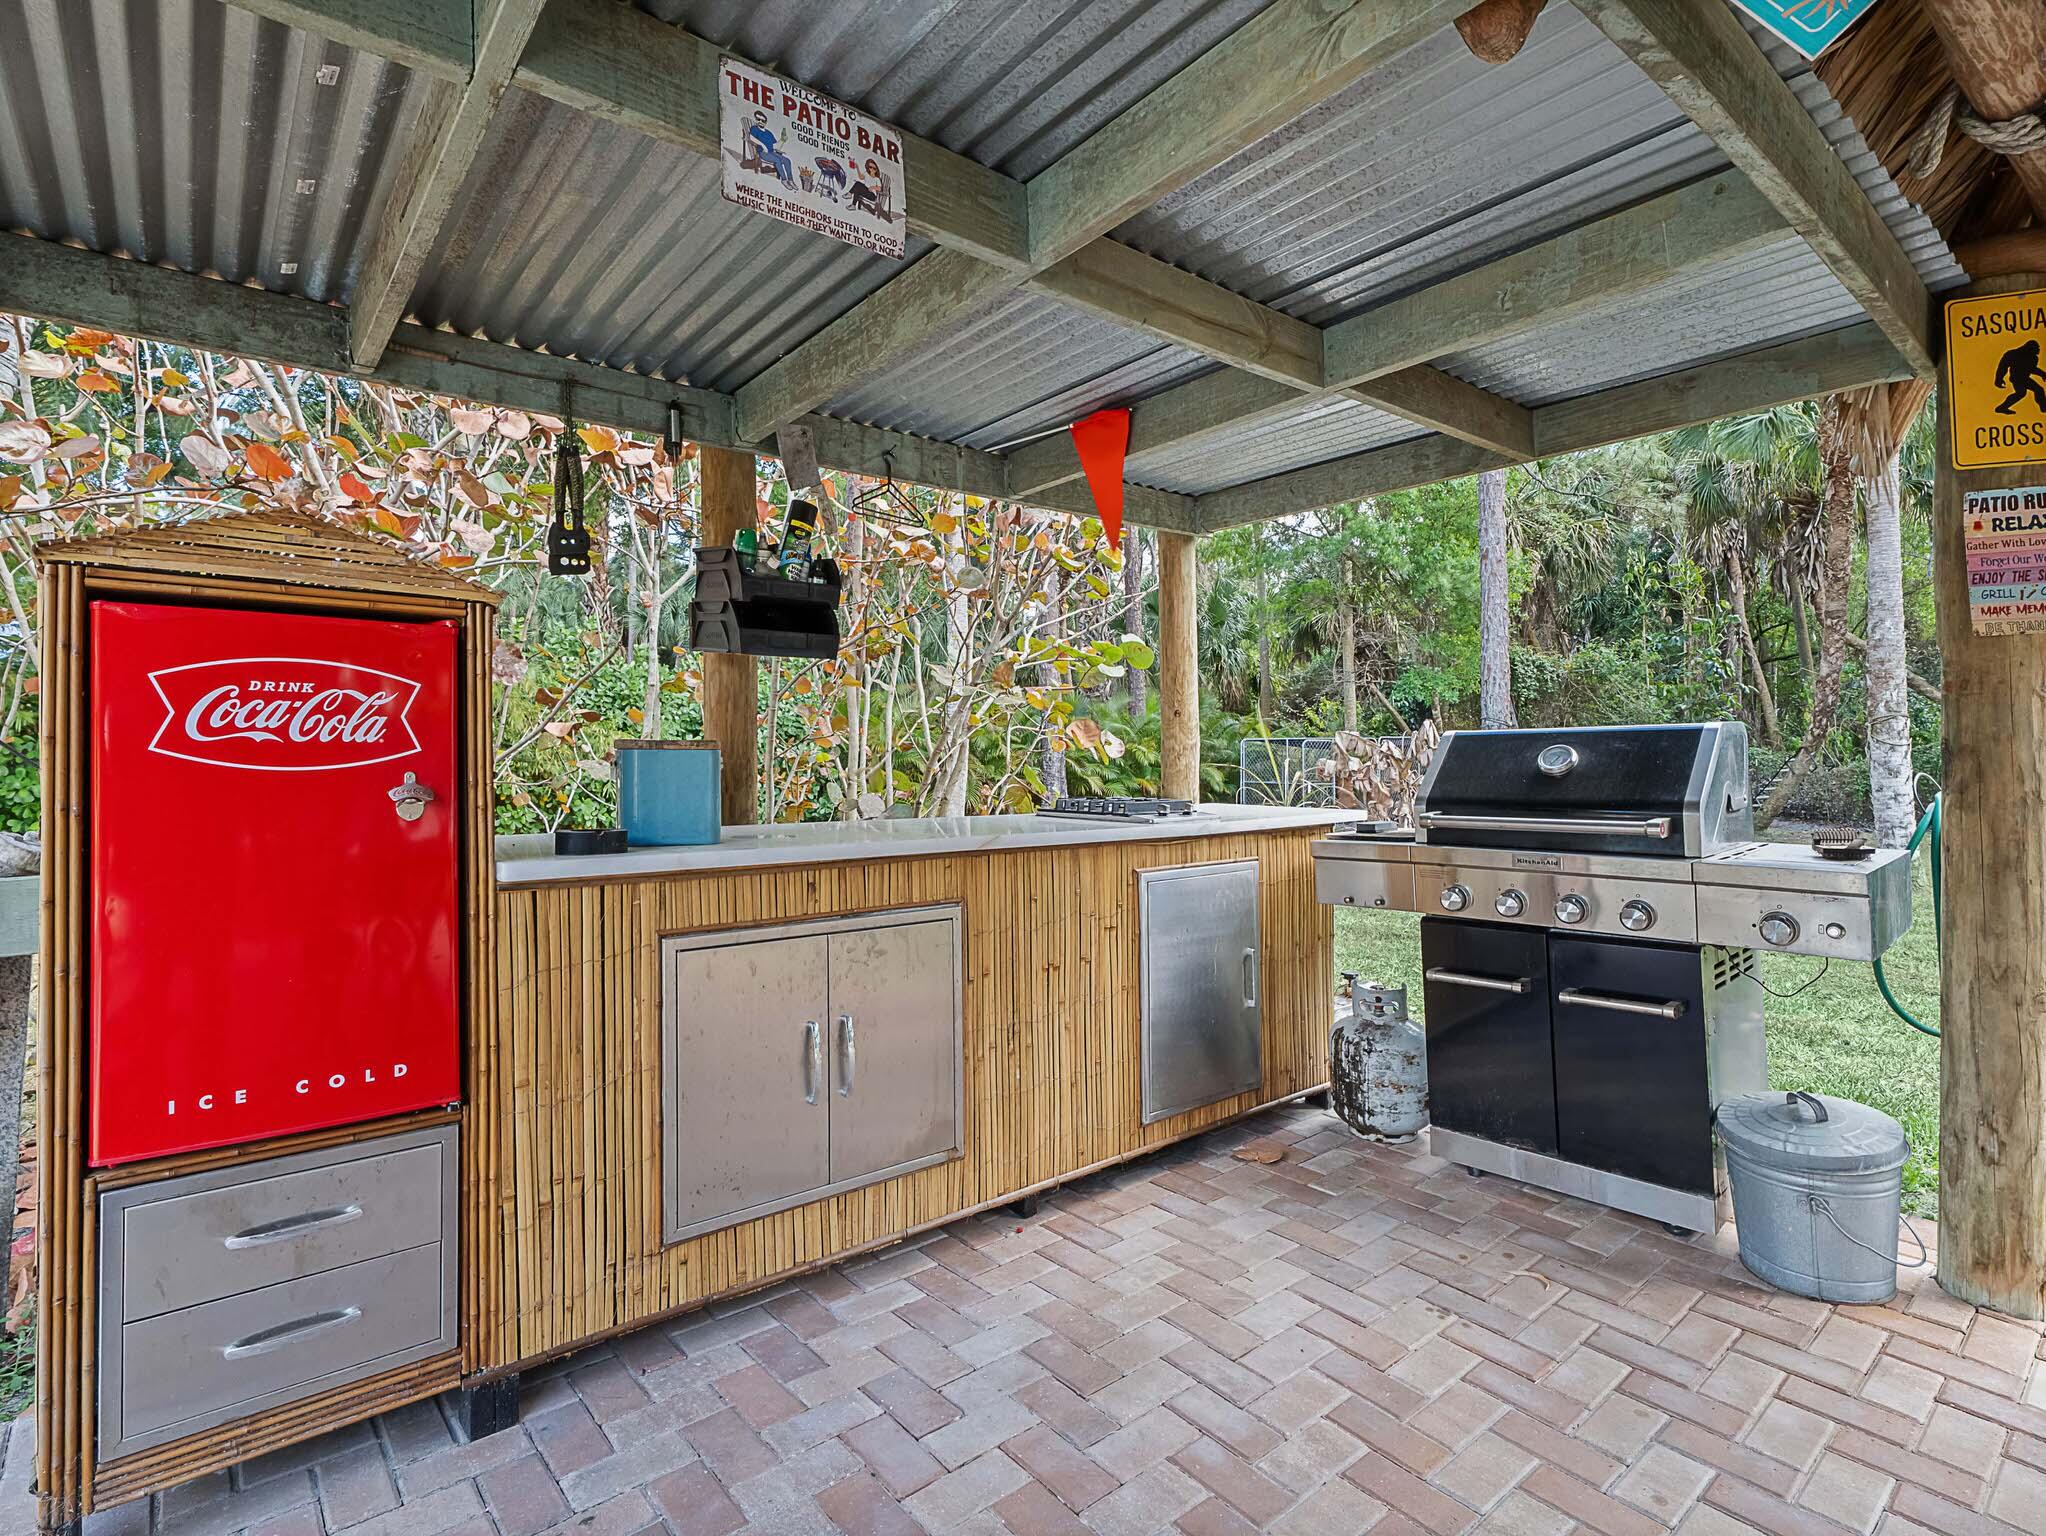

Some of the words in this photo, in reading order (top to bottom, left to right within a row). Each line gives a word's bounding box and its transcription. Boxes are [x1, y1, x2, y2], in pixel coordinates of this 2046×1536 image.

[779, 80, 838, 113] WELCOME
[840, 107, 857, 121] TO
[725, 69, 775, 111] THE
[781, 94, 851, 141] PATIO
[857, 125, 900, 164] BAR
[791, 121, 814, 137] GOOD
[816, 131, 850, 152] FRIENDS
[797, 133, 819, 149] GOOD
[821, 142, 845, 159] TIMES
[735, 181, 765, 201] WHERE
[766, 194, 783, 207] THE
[784, 200, 832, 224] NEIGHBORS
[833, 218, 860, 235] LISTEN
[861, 228, 872, 239] TO
[873, 233, 898, 248] GOOD
[736, 194, 765, 212] MUSIC
[766, 204, 806, 226] WHETHER
[807, 219, 827, 233] THEY
[828, 226, 852, 241] WANT
[852, 235, 864, 246] TO
[865, 240, 877, 251] OR
[1961, 307, 2046, 338] SASQUA
[1975, 422, 2044, 449] CROSS
[1968, 494, 2019, 514] PATIO
[1966, 540, 1999, 551] Gather
[2000, 538, 2026, 548] With
[1980, 555, 2010, 568] Forget
[2012, 554, 2031, 565] Our
[1971, 571, 2006, 585] ENJOY
[2012, 569, 2032, 582] THE
[1981, 588, 2016, 600] GRILL
[1980, 605, 2012, 617] MAKE
[2016, 602, 2046, 615] MEM
[1984, 622, 2003, 633] BE
[2007, 620, 2046, 631] THAN
[248, 680, 316, 693] DRINK
[184, 684, 399, 744] Coca-Cola
[168, 1089, 247, 1115] ICE
[295, 1063, 408, 1094] COLD
